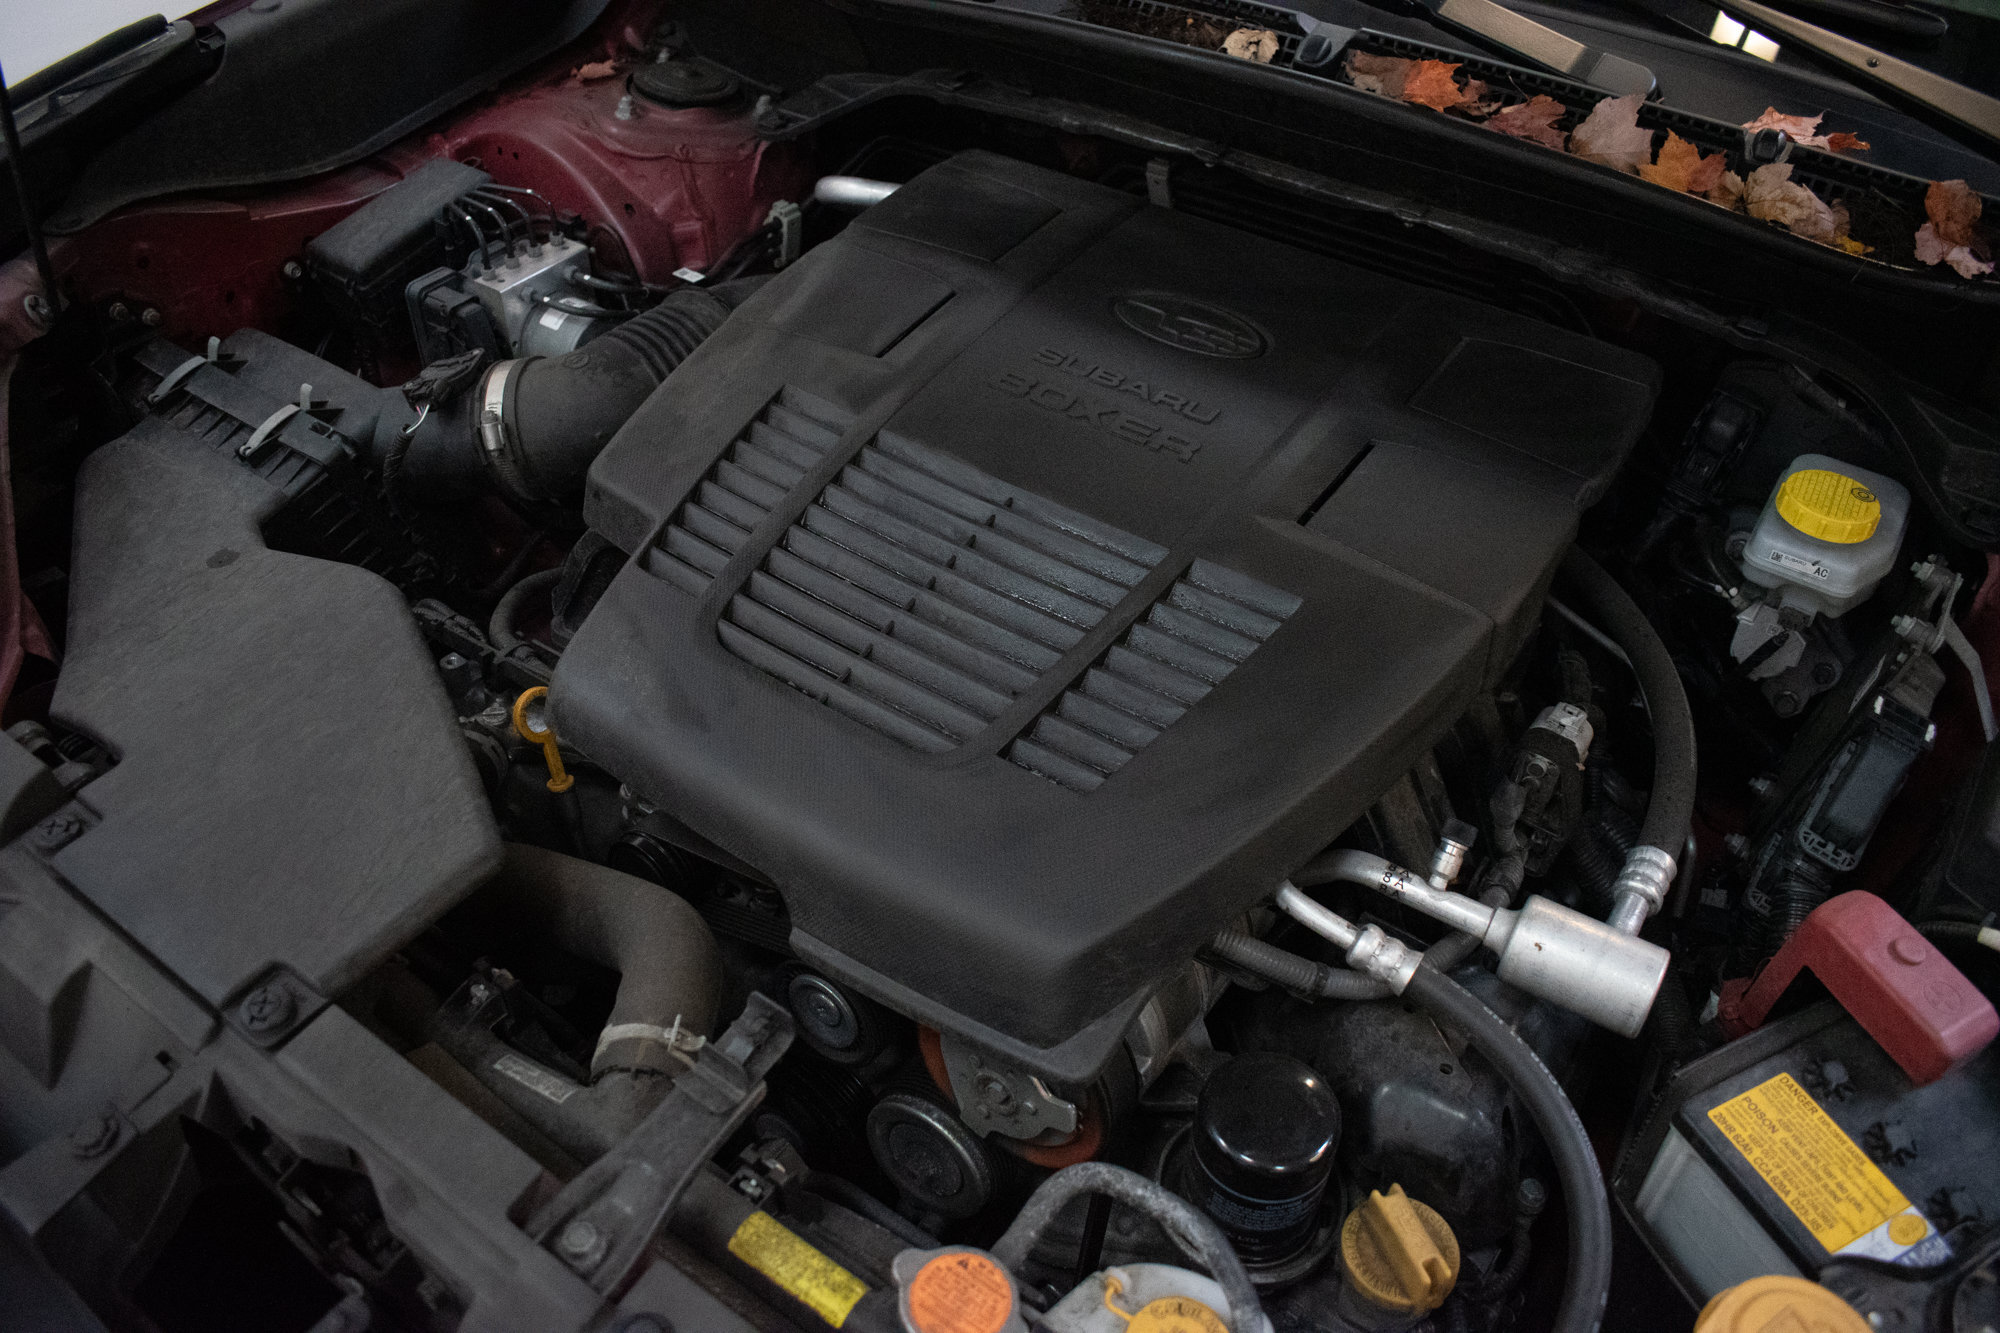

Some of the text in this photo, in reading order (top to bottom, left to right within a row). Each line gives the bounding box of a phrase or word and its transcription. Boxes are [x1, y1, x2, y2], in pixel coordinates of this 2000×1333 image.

[1032, 344, 1221, 425] SUBARU
[989, 371, 1204, 464] BOXER
[1813, 566, 1829, 578] AC
[1740, 1095, 1780, 1134] POISON
[1777, 1075, 1819, 1115] DANGER
[1711, 1111, 1736, 1135] 20HR
[1751, 1156, 1773, 1176] CCA
